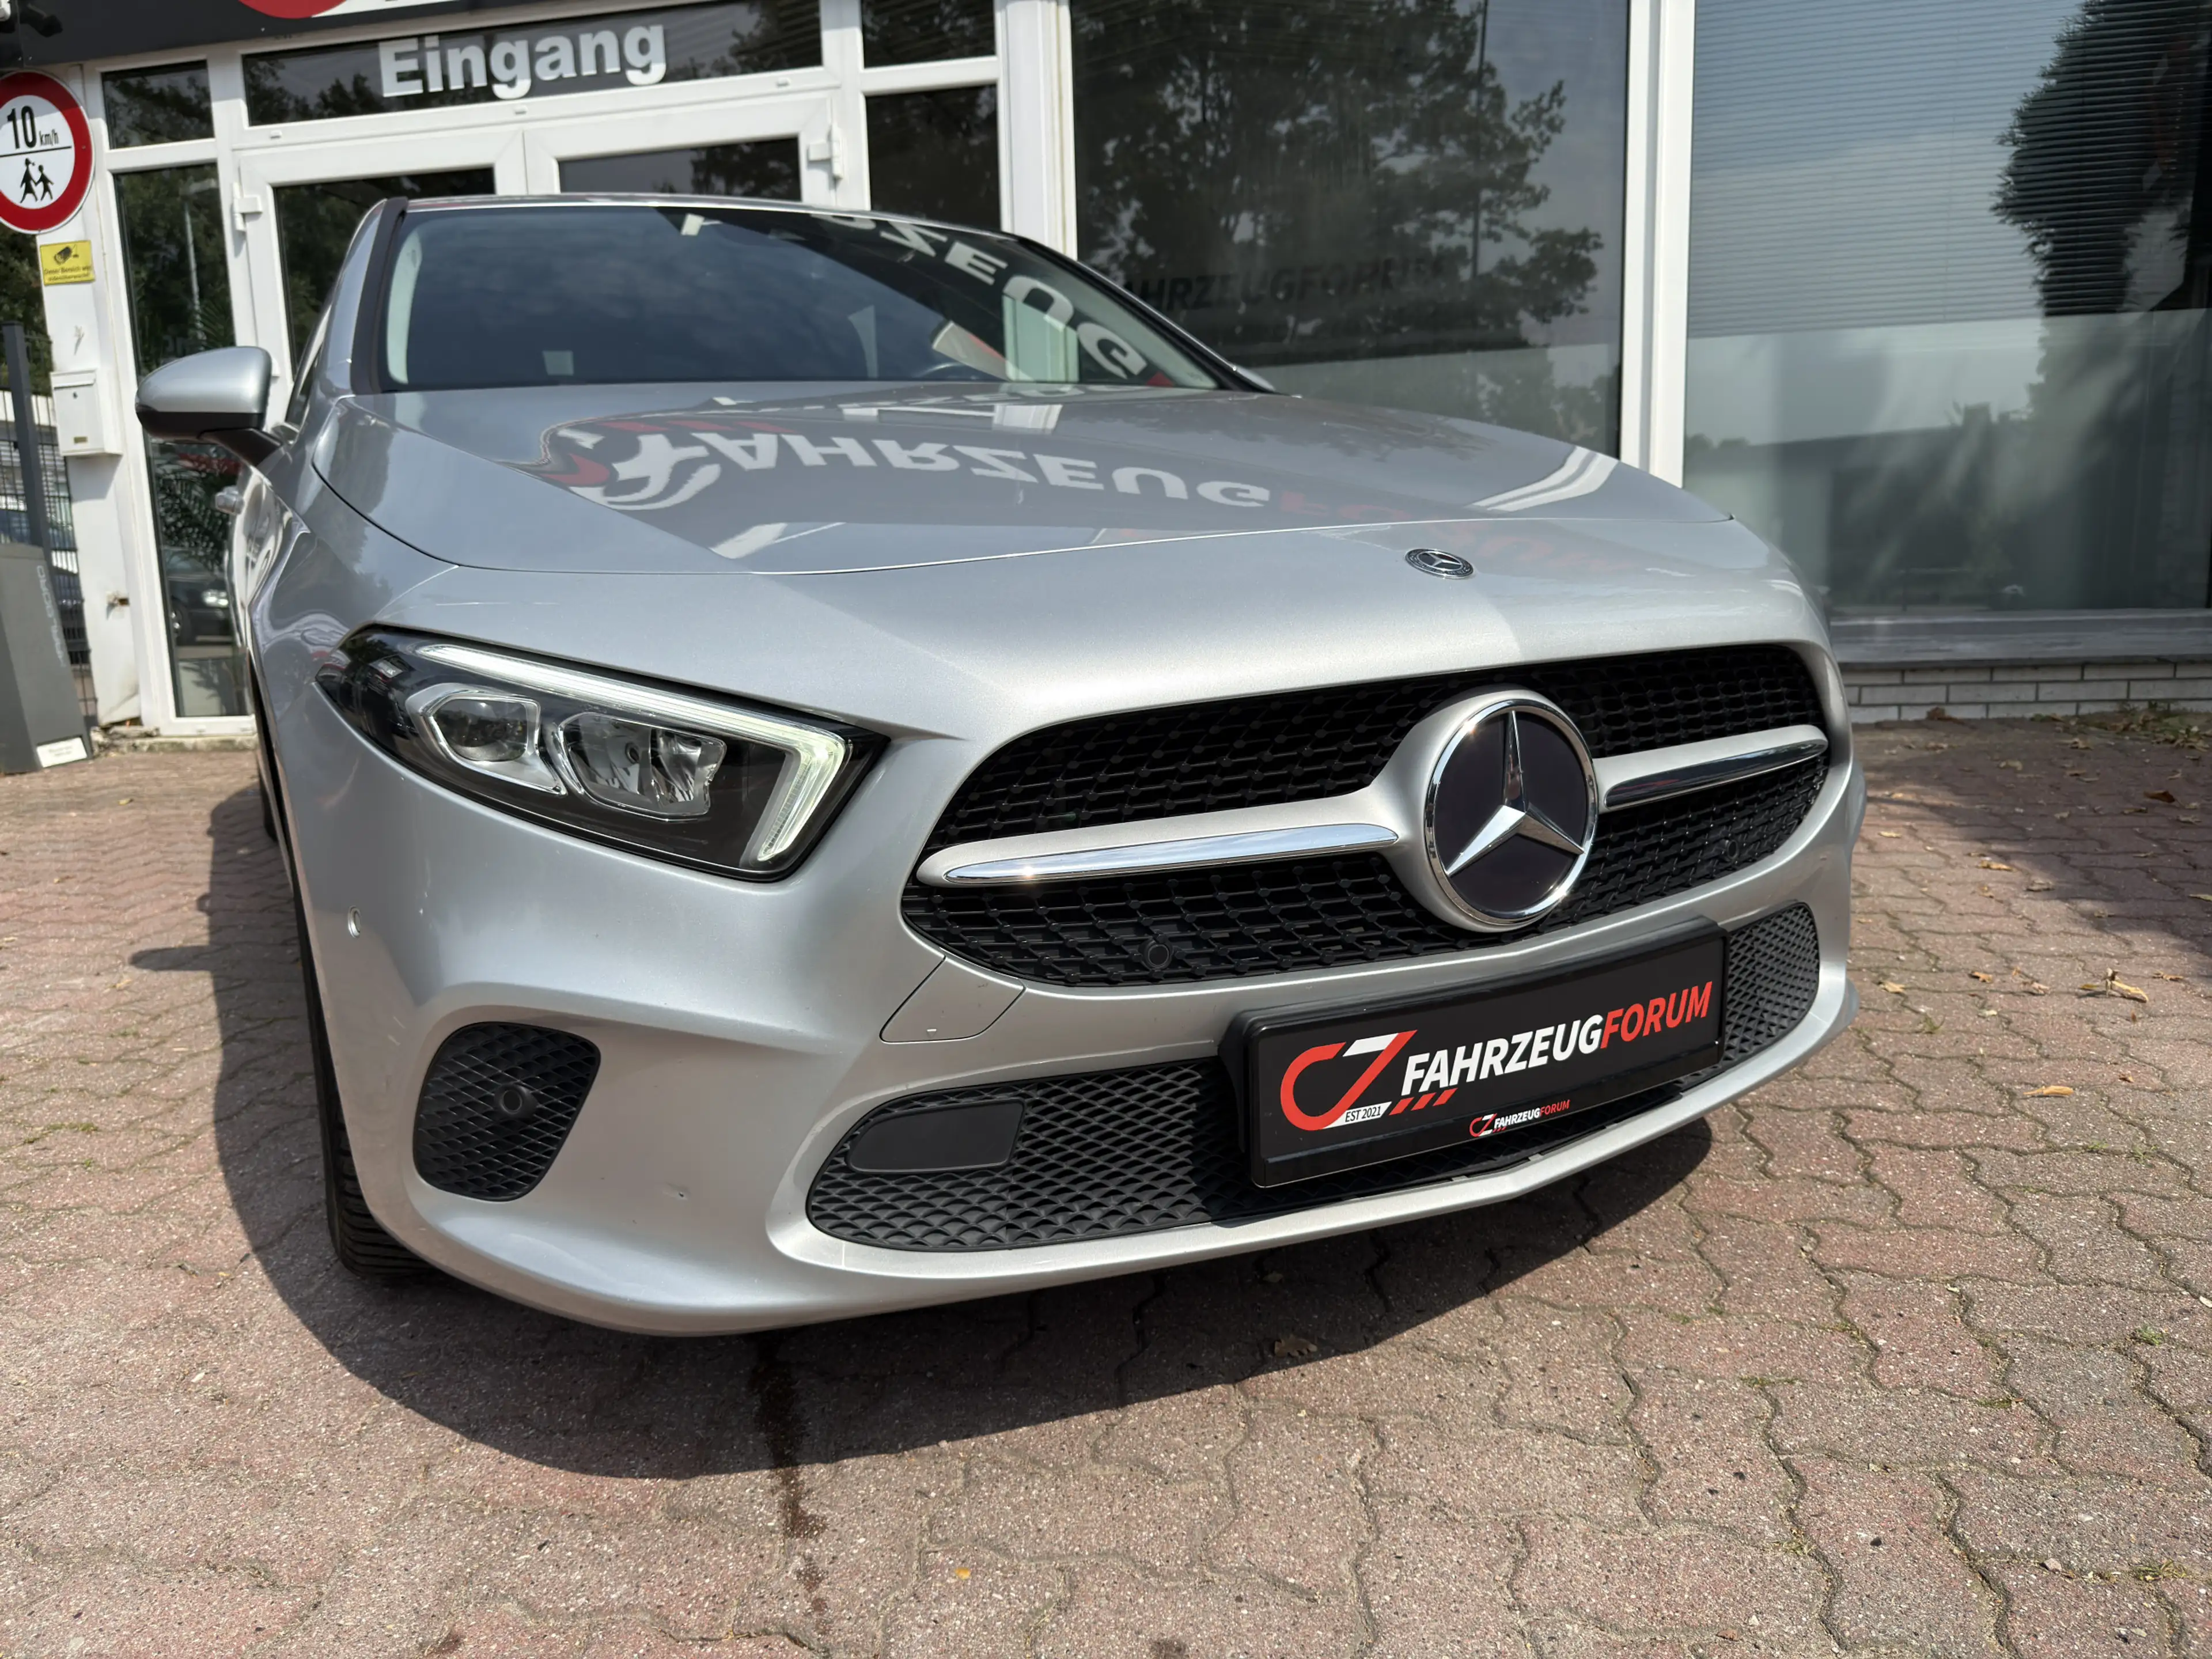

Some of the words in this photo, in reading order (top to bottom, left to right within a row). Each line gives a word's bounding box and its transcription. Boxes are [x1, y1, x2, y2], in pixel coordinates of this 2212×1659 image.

[378, 25, 666, 100] Eingang
[7, 105, 36, 149] 10
[39, 128, 59, 146] km/h
[1401, 981, 1713, 1096] FAHRZEUGFORUM
[1344, 1109, 1361, 1123] EST
[1361, 1105, 1381, 1119] 2021
